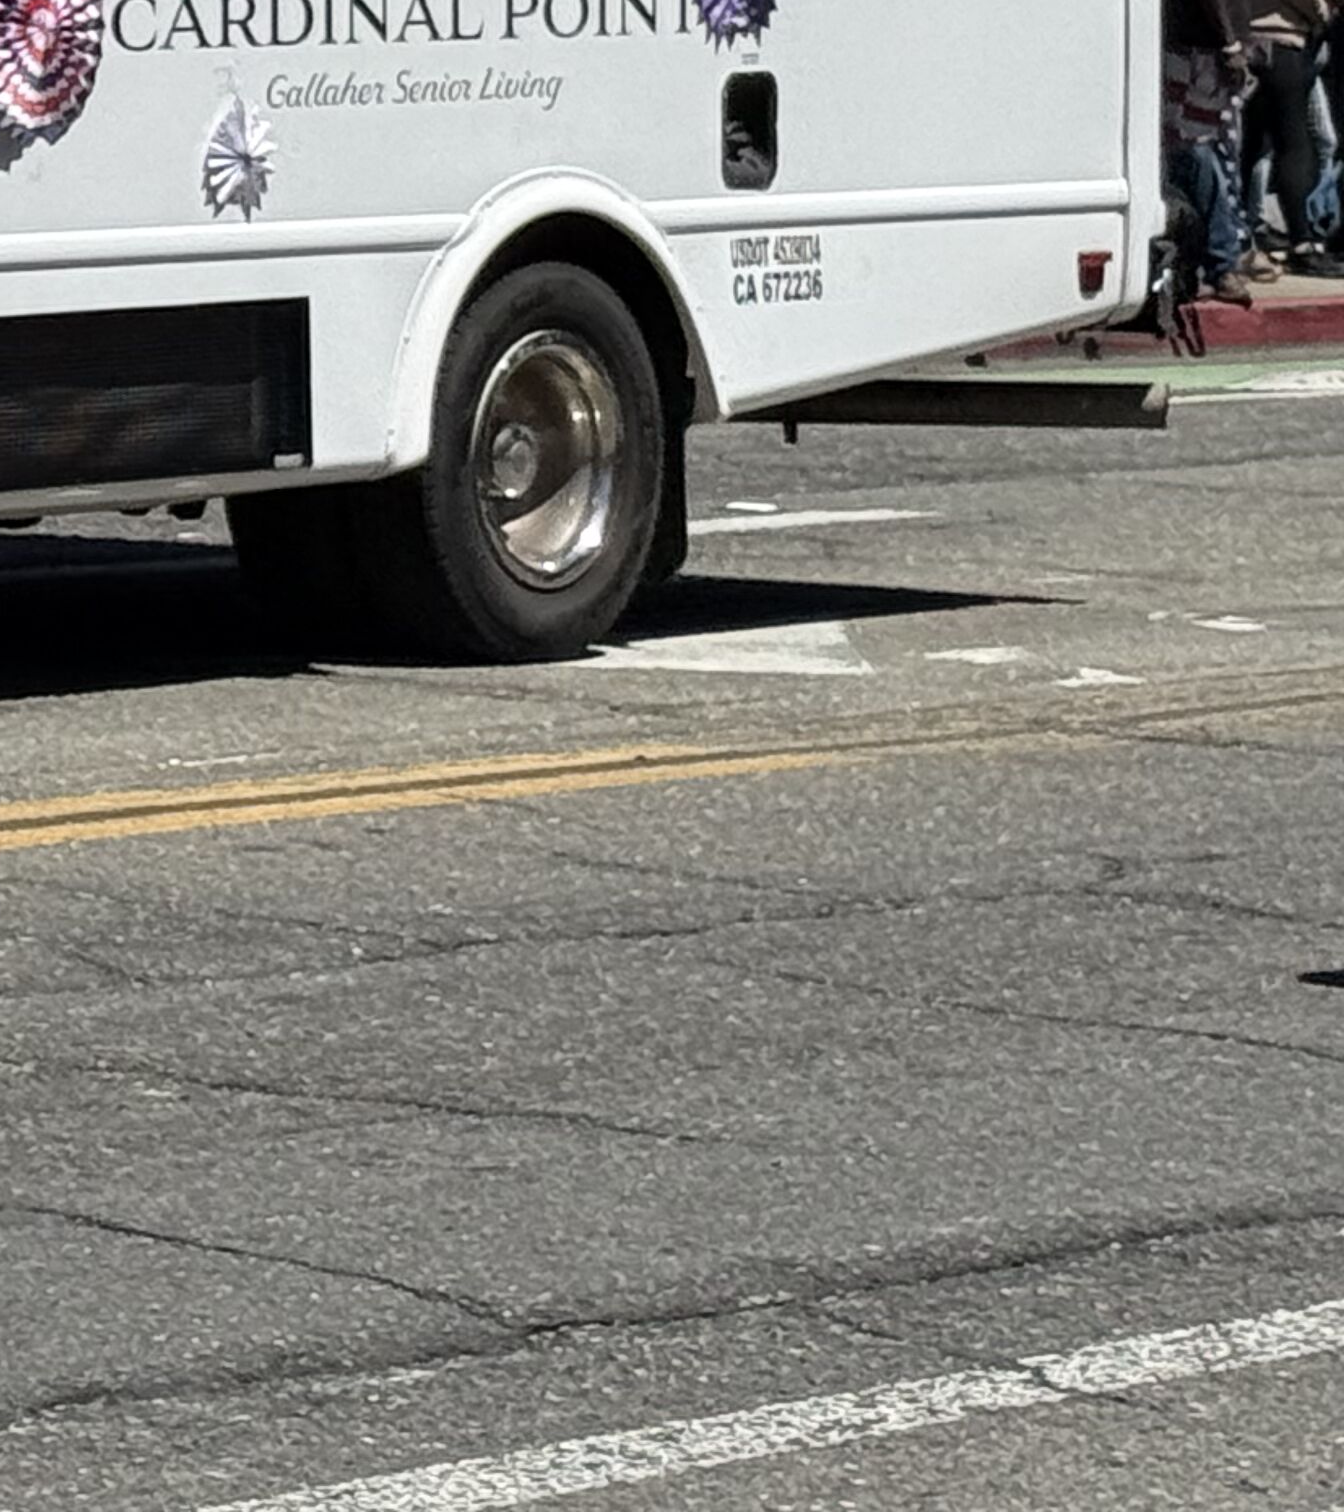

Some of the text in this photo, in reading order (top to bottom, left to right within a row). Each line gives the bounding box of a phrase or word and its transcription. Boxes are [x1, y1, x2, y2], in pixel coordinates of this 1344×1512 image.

[266, 66, 563, 112] Gallaher Senior Living
[733, 268, 823, 305] CA 672236
